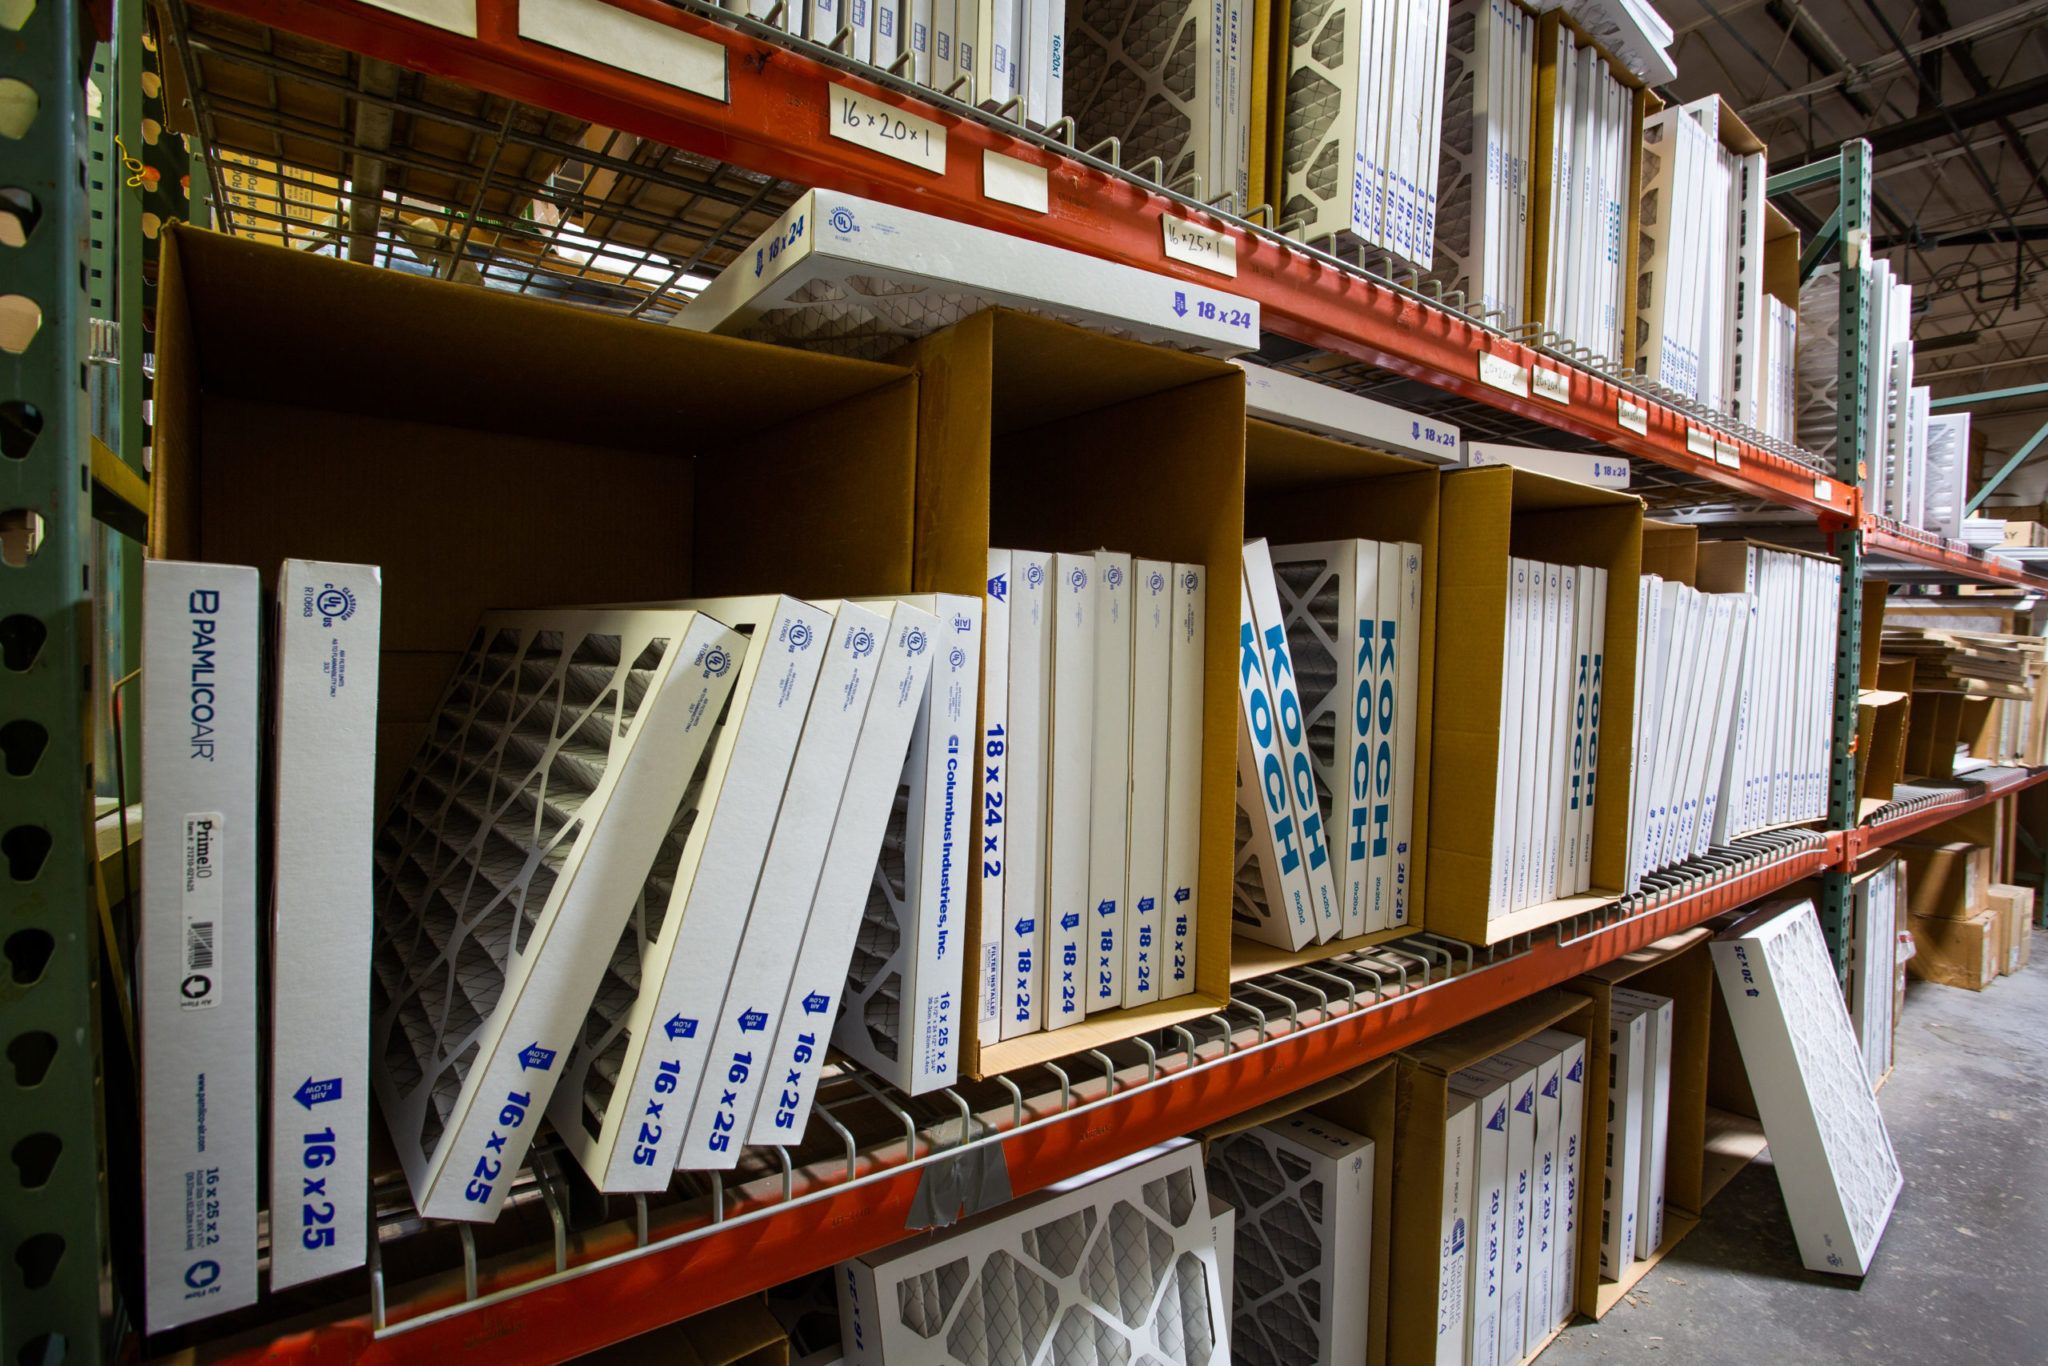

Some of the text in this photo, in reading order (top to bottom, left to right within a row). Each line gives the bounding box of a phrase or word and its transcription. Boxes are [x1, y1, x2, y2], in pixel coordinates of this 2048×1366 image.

[788, 214, 804, 246] 24
[1197, 301, 1251, 328] 18 x 24
[1424, 428, 1456, 447] 18 x 24
[1604, 465, 1612, 476] 18
[1617, 468, 1626, 478] 24
[954, 618, 968, 628] AIR
[190, 620, 216, 760] PAMLICOAIR
[1240, 621, 1300, 876] KOCH
[1264, 624, 1328, 871] KOCH
[1350, 618, 1374, 862] KOCH
[1372, 619, 1396, 858] KOCH
[1571, 654, 1588, 810] KOCH
[1586, 654, 1602, 808] KOCH
[983, 724, 1004, 879] 18 x 24 x 2
[197, 820, 212, 878] Prime10
[1396, 863, 1405, 919] 20 x 20
[936, 931, 948, 960] Inc.
[1062, 942, 1076, 1014] 18 x 24
[1100, 928, 1113, 998] 18 x 24
[1138, 924, 1152, 992] 18 x 24
[1174, 914, 1188, 982] 18 x 24
[1734, 945, 1747, 960] 25
[1740, 968, 1754, 984] 20
[1016, 948, 1032, 1022] 18 x 24
[527, 1050, 550, 1060] FLOW
[672, 1020, 692, 1028] FLOW
[936, 992, 950, 1074] 16 x 25 x 2
[305, 1082, 333, 1094] FLOW
[311, 1091, 327, 1100] AIR
[528, 1057, 542, 1065] AIR
[775, 1032, 816, 1130] 16 x 25
[632, 1060, 680, 1166] 16 x 25
[708, 1051, 752, 1152] 16 x 25
[464, 1091, 531, 1204] 16 x 25
[1566, 1134, 1576, 1232] 20 x 20 x 4
[206, 1166, 220, 1246] 16 x 25 x 2
[302, 1126, 336, 1250] 16 x 25
[1516, 1169, 1527, 1274] 20 x 20 x 4
[1541, 1152, 1552, 1252] 20 x 20 x 4
[1488, 1188, 1500, 1297] 20 x 20 x 4
[848, 1266, 858, 1302] 25
[1438, 1234, 1450, 1336] 20 x 20 x 4
[854, 1320, 864, 1351] 16
